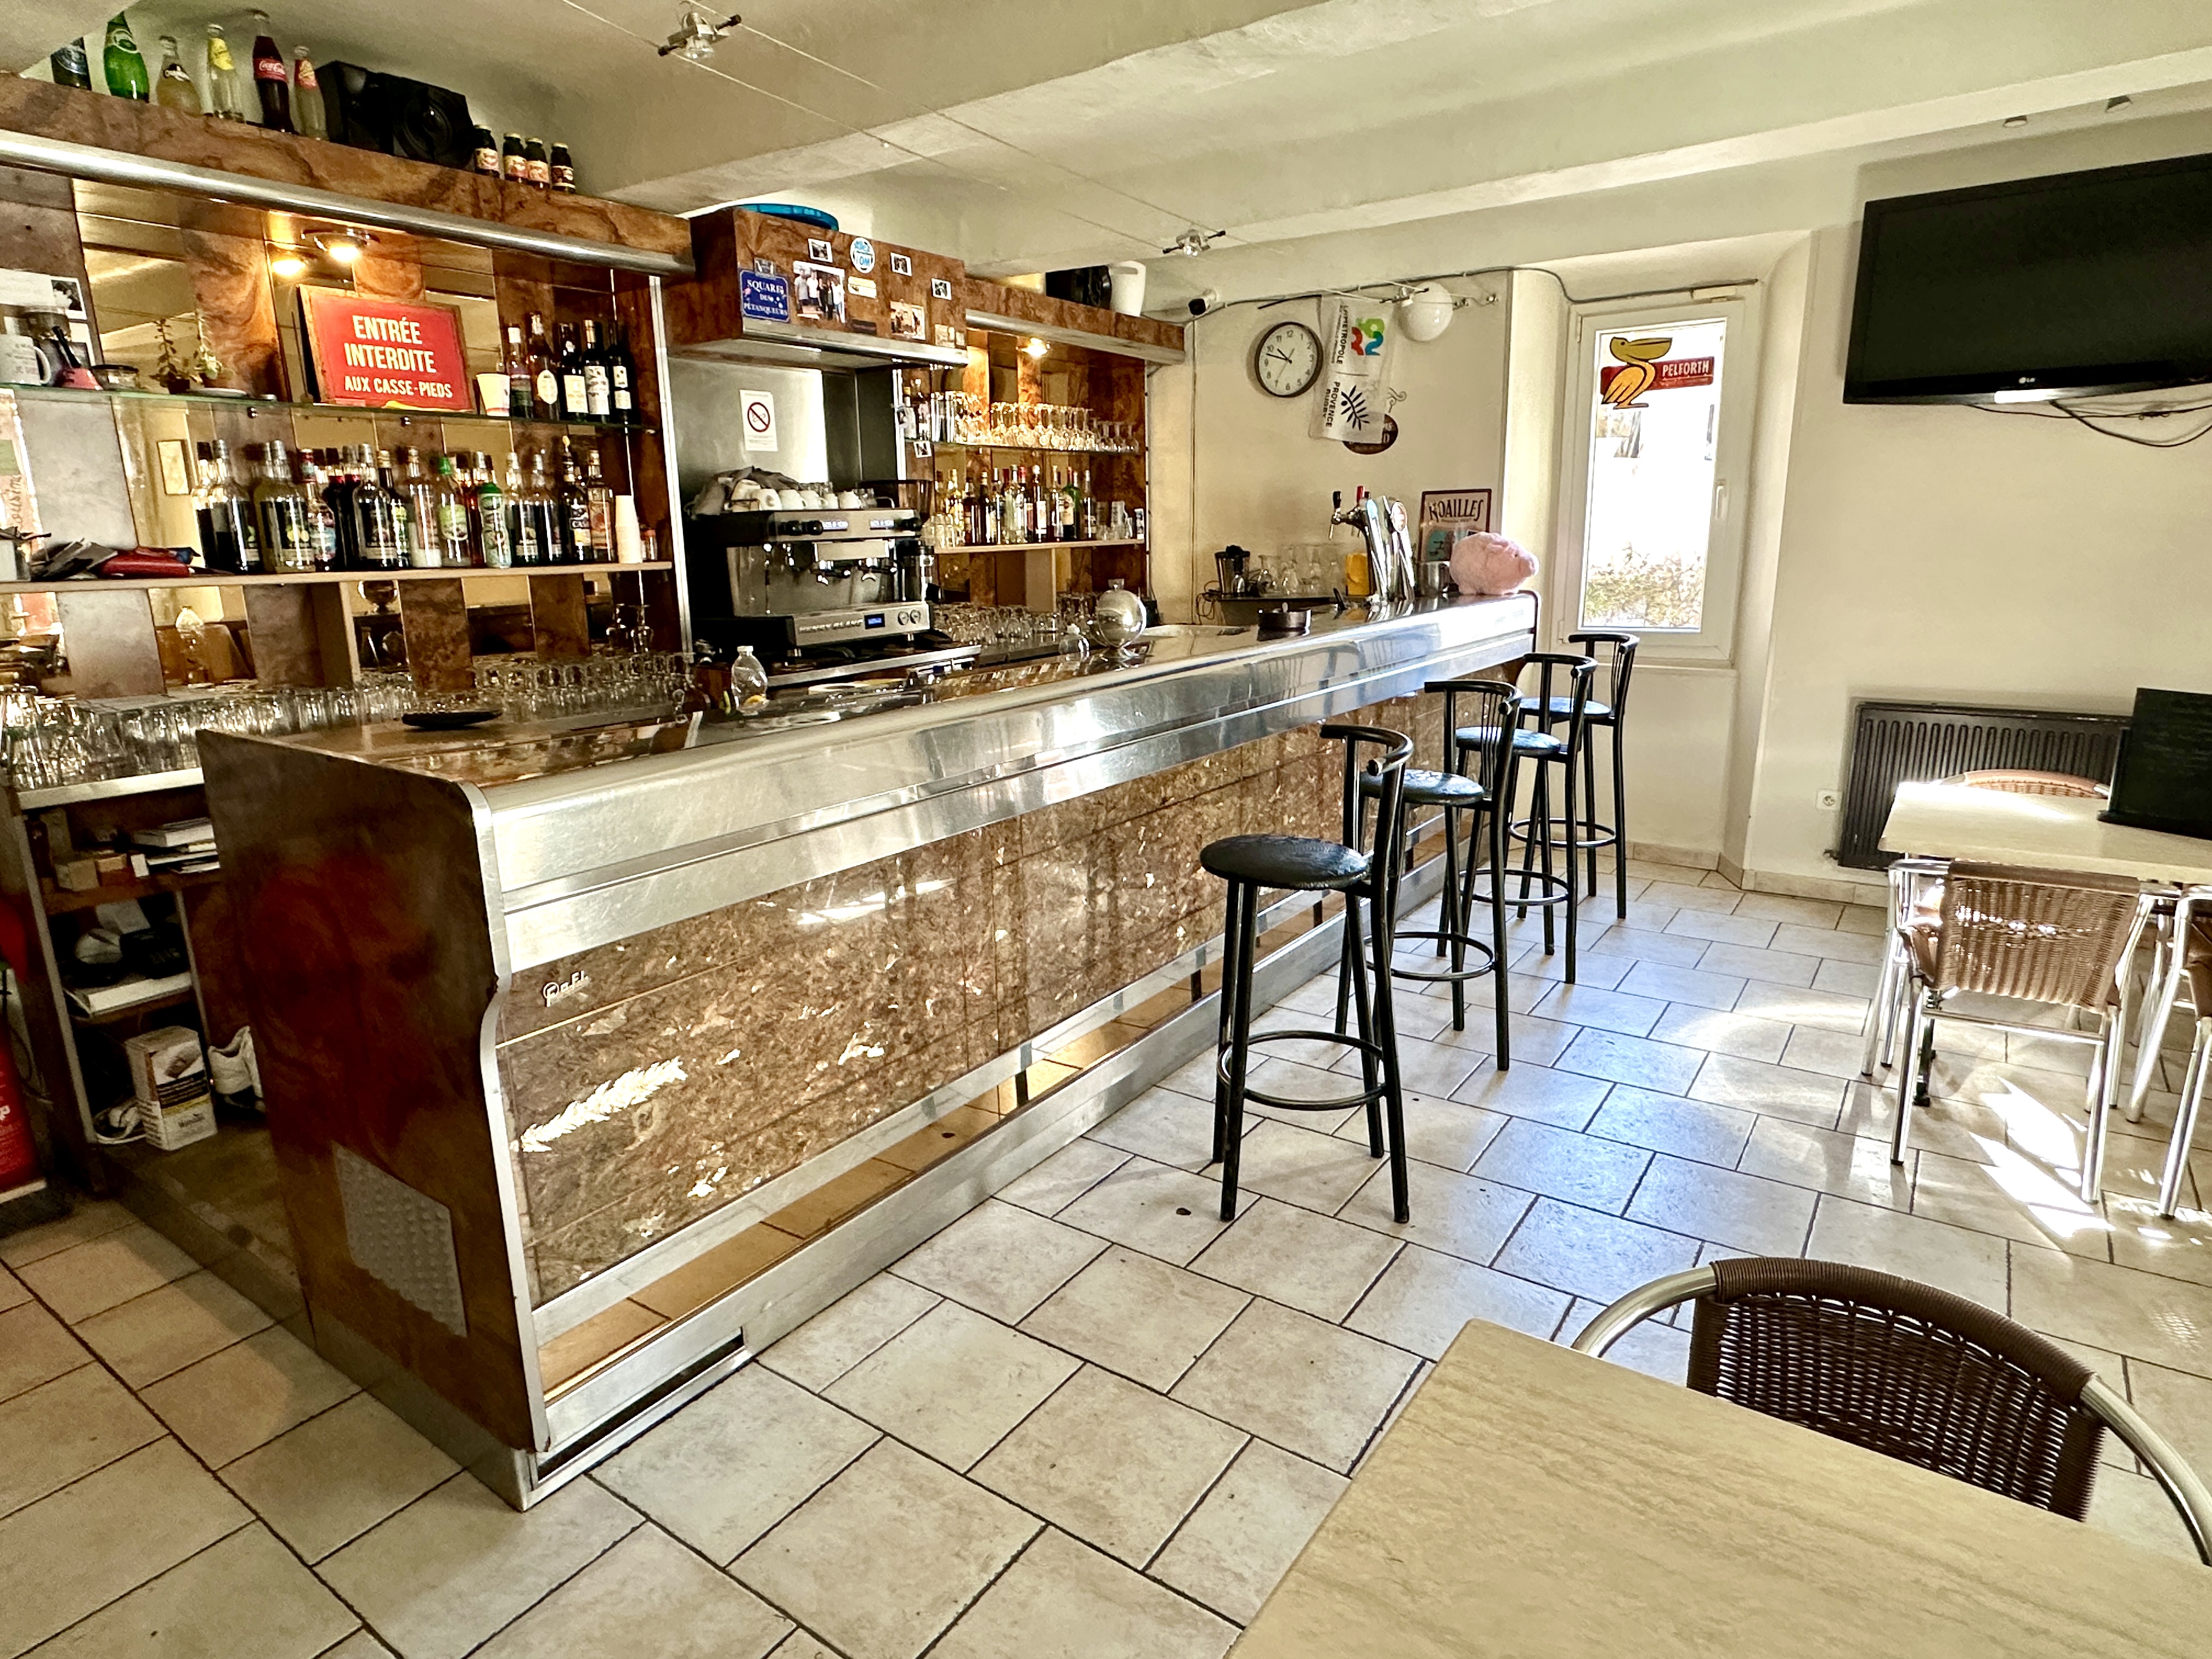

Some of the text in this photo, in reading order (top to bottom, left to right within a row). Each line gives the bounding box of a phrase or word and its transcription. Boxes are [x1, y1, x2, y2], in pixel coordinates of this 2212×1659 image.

[352, 315, 422, 345] ENTRÉE
[1286, 329, 1294, 338] 12
[1307, 341, 1313, 350] 2
[344, 342, 437, 373] INTERDITE
[1309, 354, 1314, 363] 3
[1662, 360, 1709, 377] PELFORTH
[345, 375, 453, 398] AUX CASSE-PIEDS
[1325, 381, 1341, 427] PROVENCE
[1429, 499, 1483, 523] NOAILLES
